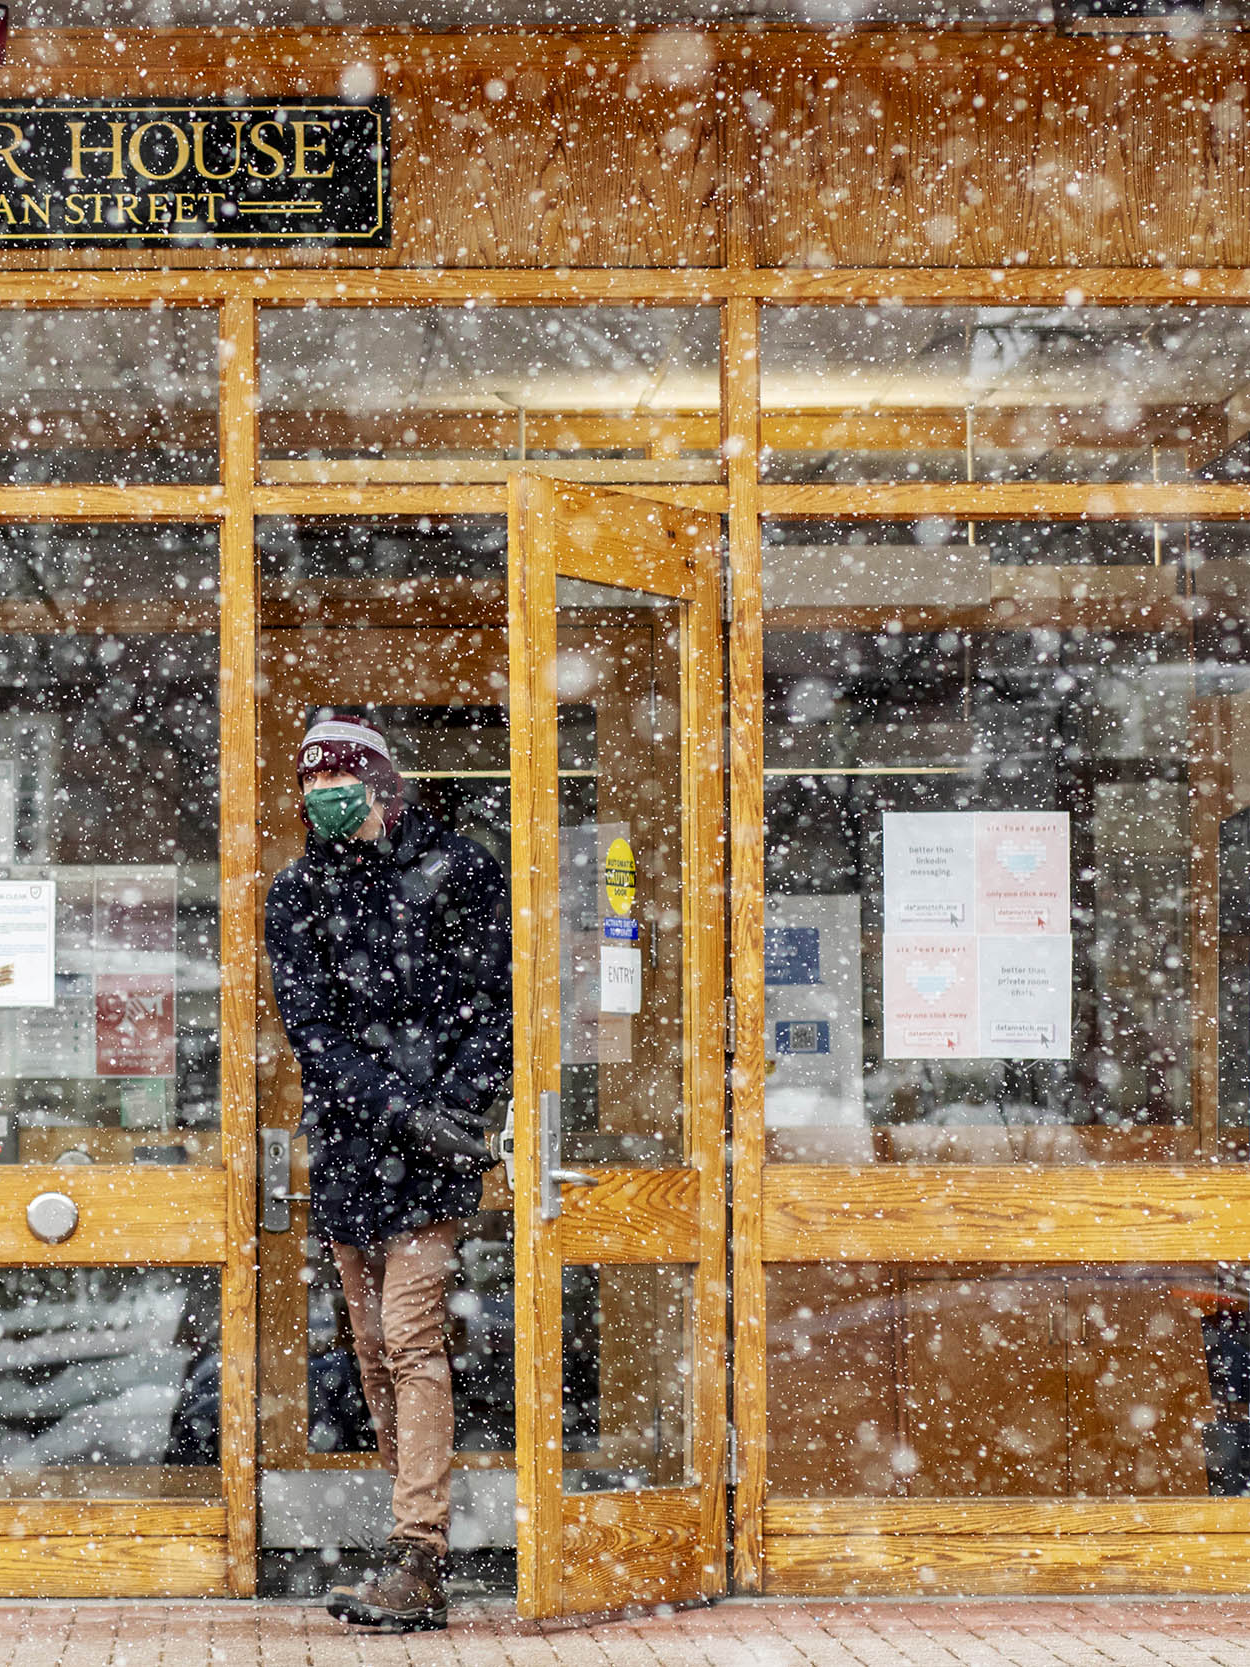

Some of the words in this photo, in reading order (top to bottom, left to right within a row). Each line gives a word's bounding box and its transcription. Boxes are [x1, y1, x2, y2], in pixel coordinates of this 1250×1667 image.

[64, 120, 336, 181] HOUSE
[64, 192, 227, 226] STREET
[908, 845, 934, 854] better
[936, 845, 955, 854] than
[606, 870, 636, 886] CAUTION
[608, 966, 635, 985] ENTRY
[1001, 966, 1026, 975] better
[1028, 967, 1047, 975] than
[997, 977, 1026, 987] private
